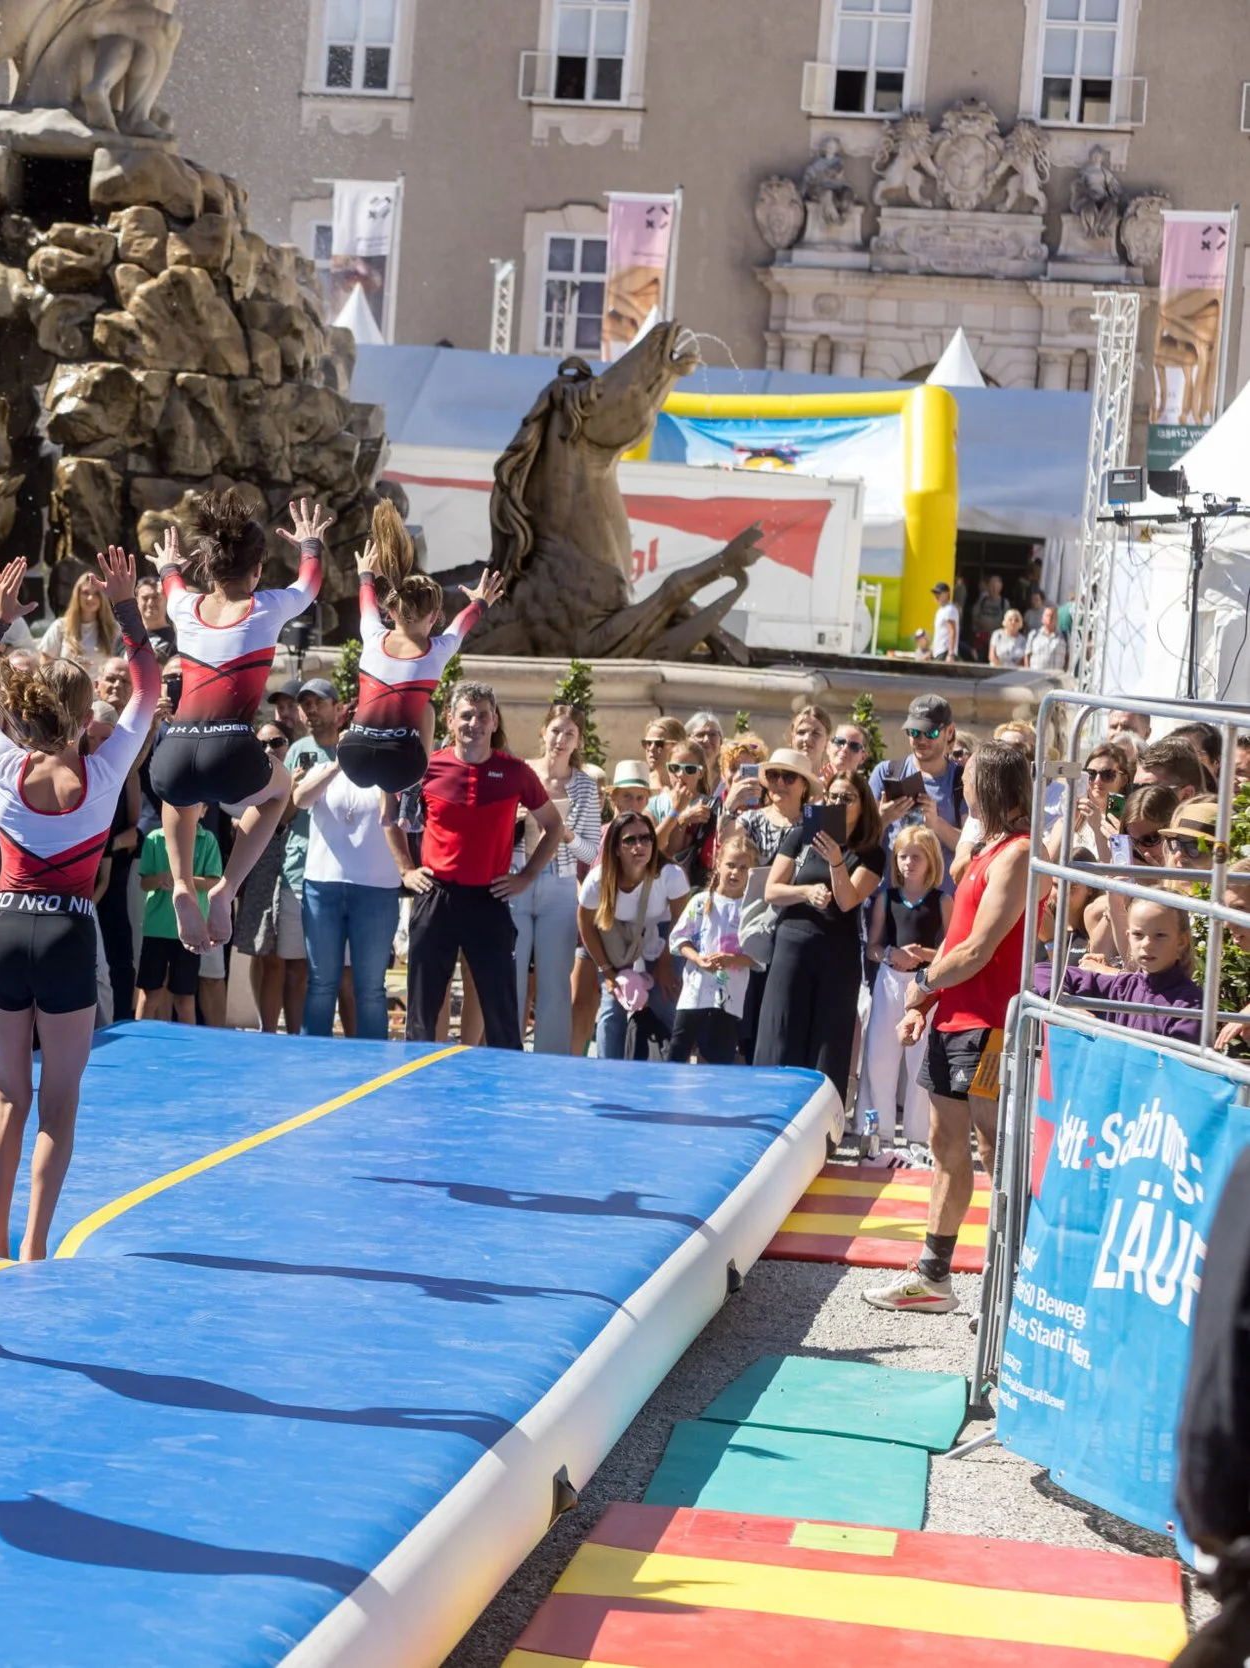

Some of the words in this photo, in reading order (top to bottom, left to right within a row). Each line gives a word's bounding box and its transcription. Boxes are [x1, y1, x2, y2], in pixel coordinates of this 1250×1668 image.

[203, 723, 249, 734] UNDER
[18, 894, 61, 912] NRO
[1027, 1316, 1066, 1352] Stadt
